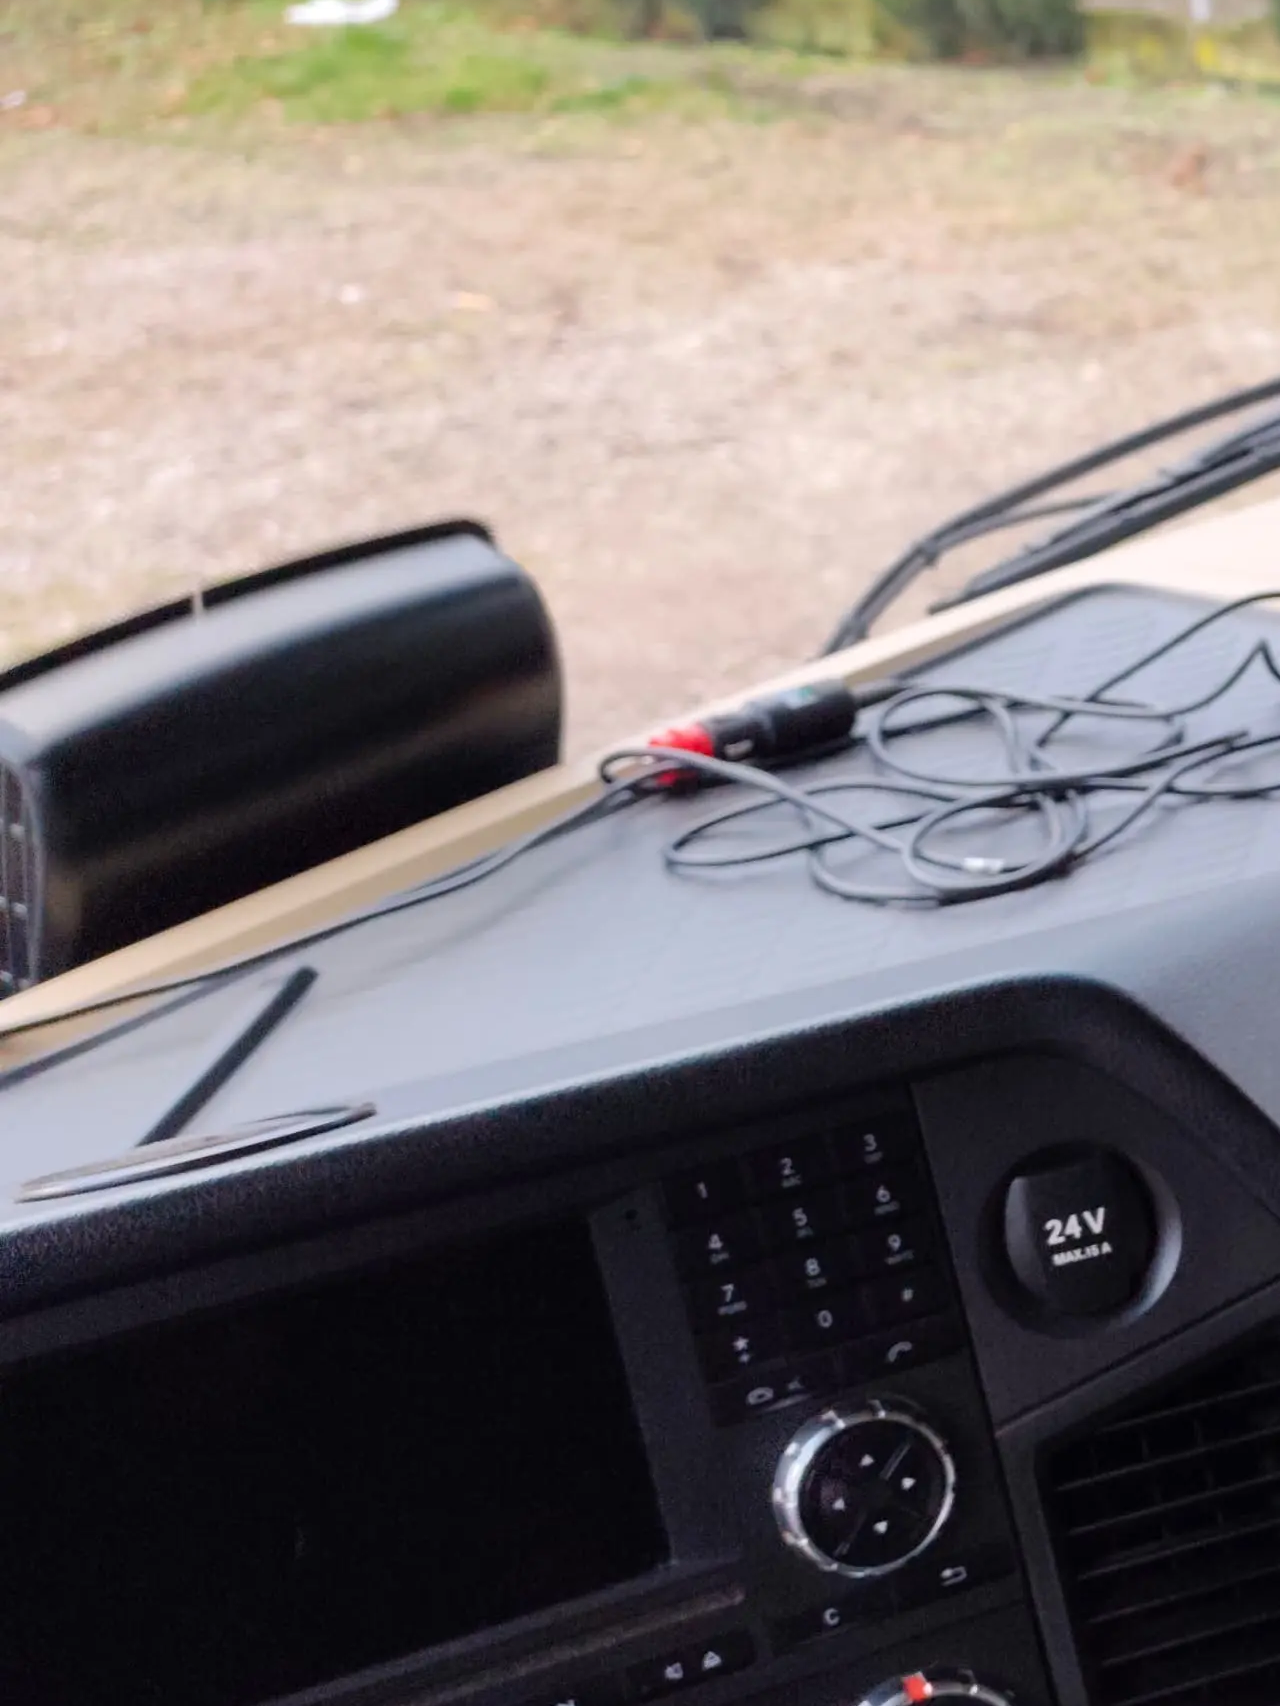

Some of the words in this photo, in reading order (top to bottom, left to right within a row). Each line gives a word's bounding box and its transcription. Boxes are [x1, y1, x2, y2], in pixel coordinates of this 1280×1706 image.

[862, 1133, 877, 1151] 3
[779, 1157, 795, 1175] 2
[696, 1180, 709, 1199] 1
[875, 1184, 891, 1203] 6
[792, 1207, 808, 1226] 5
[707, 1233, 723, 1250] 4
[887, 1233, 902, 1251] 9
[805, 1257, 821, 1277] 8
[720, 1282, 735, 1303] 7
[816, 1309, 834, 1328] 0
[823, 1607, 840, 1626] C
